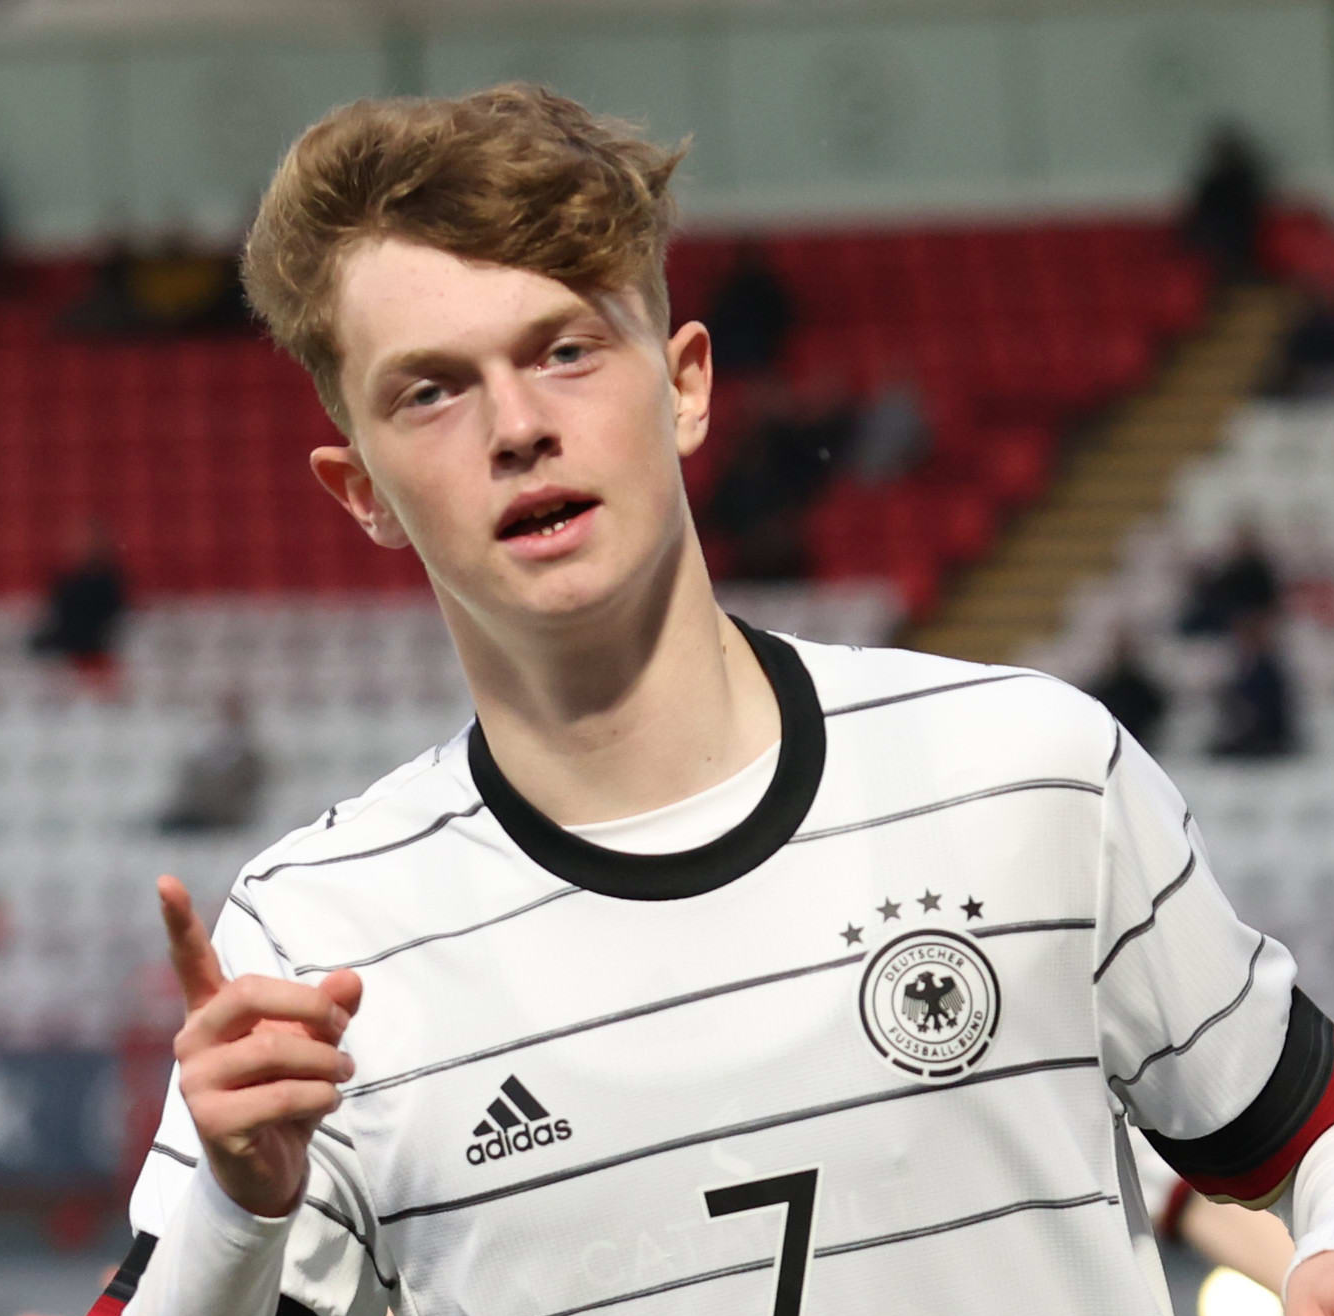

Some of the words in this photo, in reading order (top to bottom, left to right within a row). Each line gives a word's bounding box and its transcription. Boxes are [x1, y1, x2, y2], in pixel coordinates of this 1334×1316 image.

[884, 947, 965, 983] DEUTSCHER
[888, 1009, 984, 1058] FUSSBALL-BUND
[466, 1118, 573, 1166] adidas
